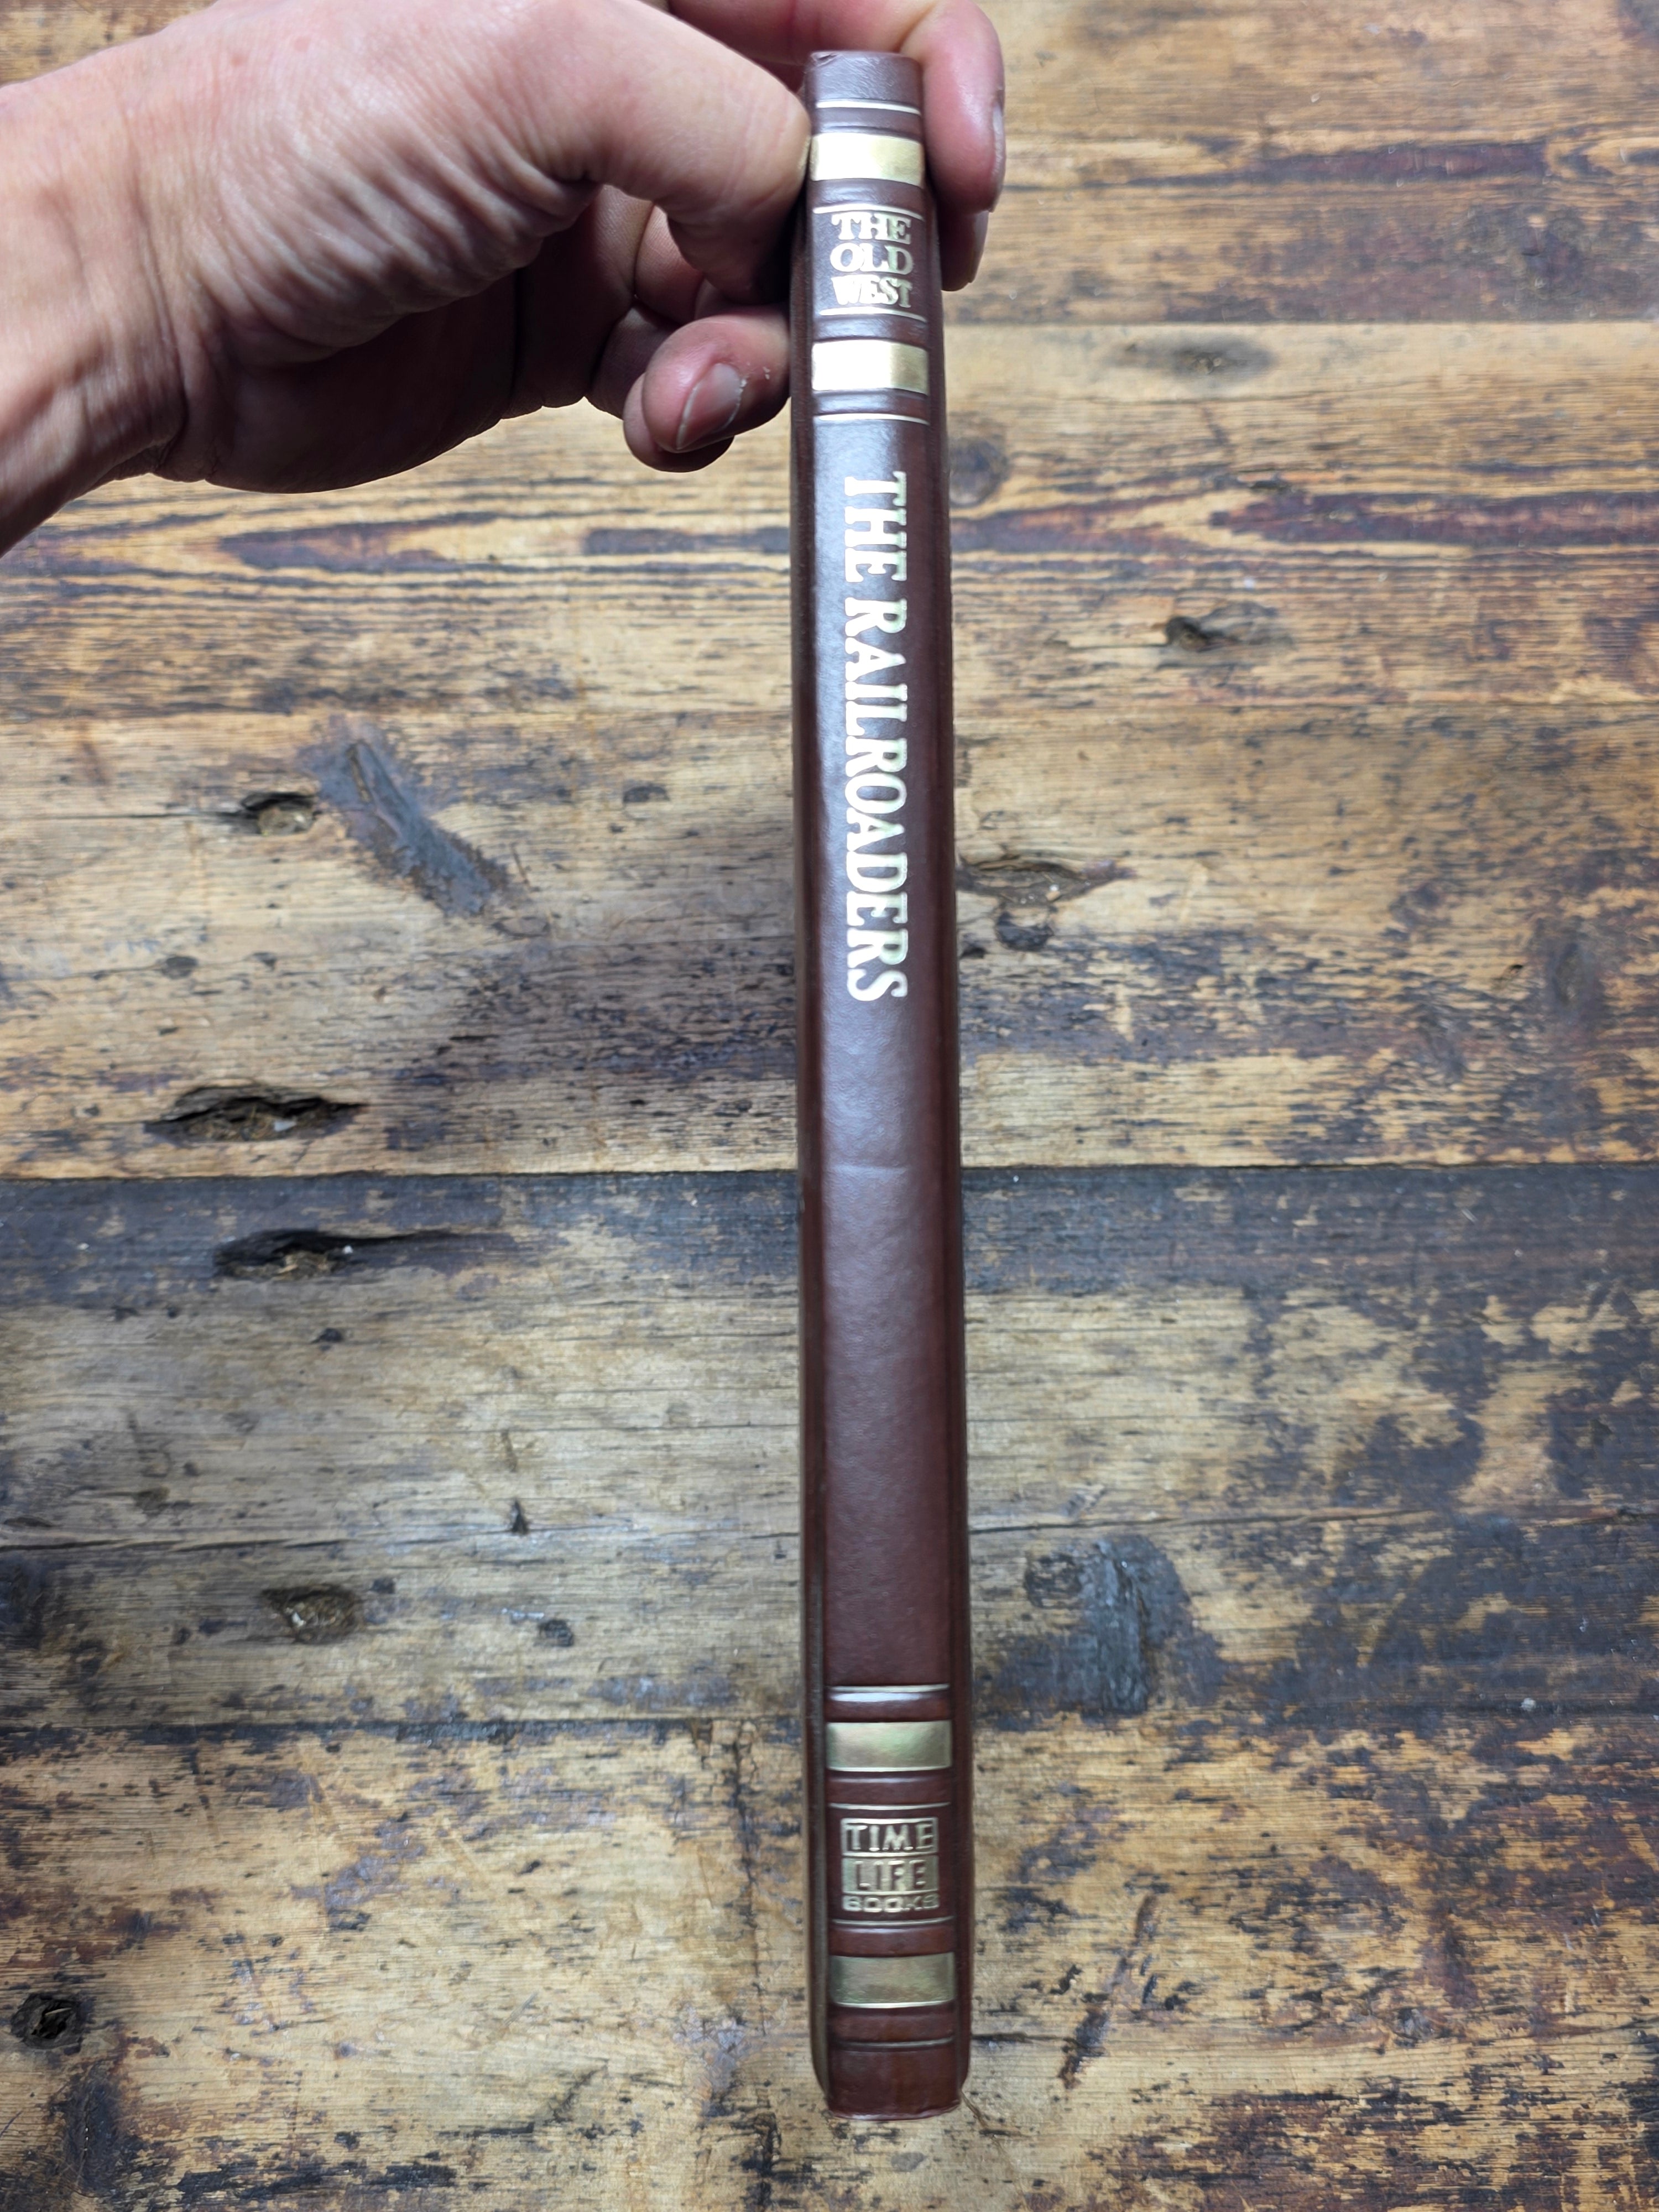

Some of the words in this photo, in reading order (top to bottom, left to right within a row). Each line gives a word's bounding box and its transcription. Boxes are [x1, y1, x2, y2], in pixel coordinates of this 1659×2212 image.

[831, 211, 911, 244] THE
[830, 243, 912, 275] OLD
[831, 274, 912, 307] WEST
[844, 471, 907, 583] THE
[844, 597, 908, 1001] RAILROADERS
[845, 1824, 934, 1851] TIME
[852, 1859, 927, 1890] LIFE
[843, 1894, 939, 1912] BOOKS
